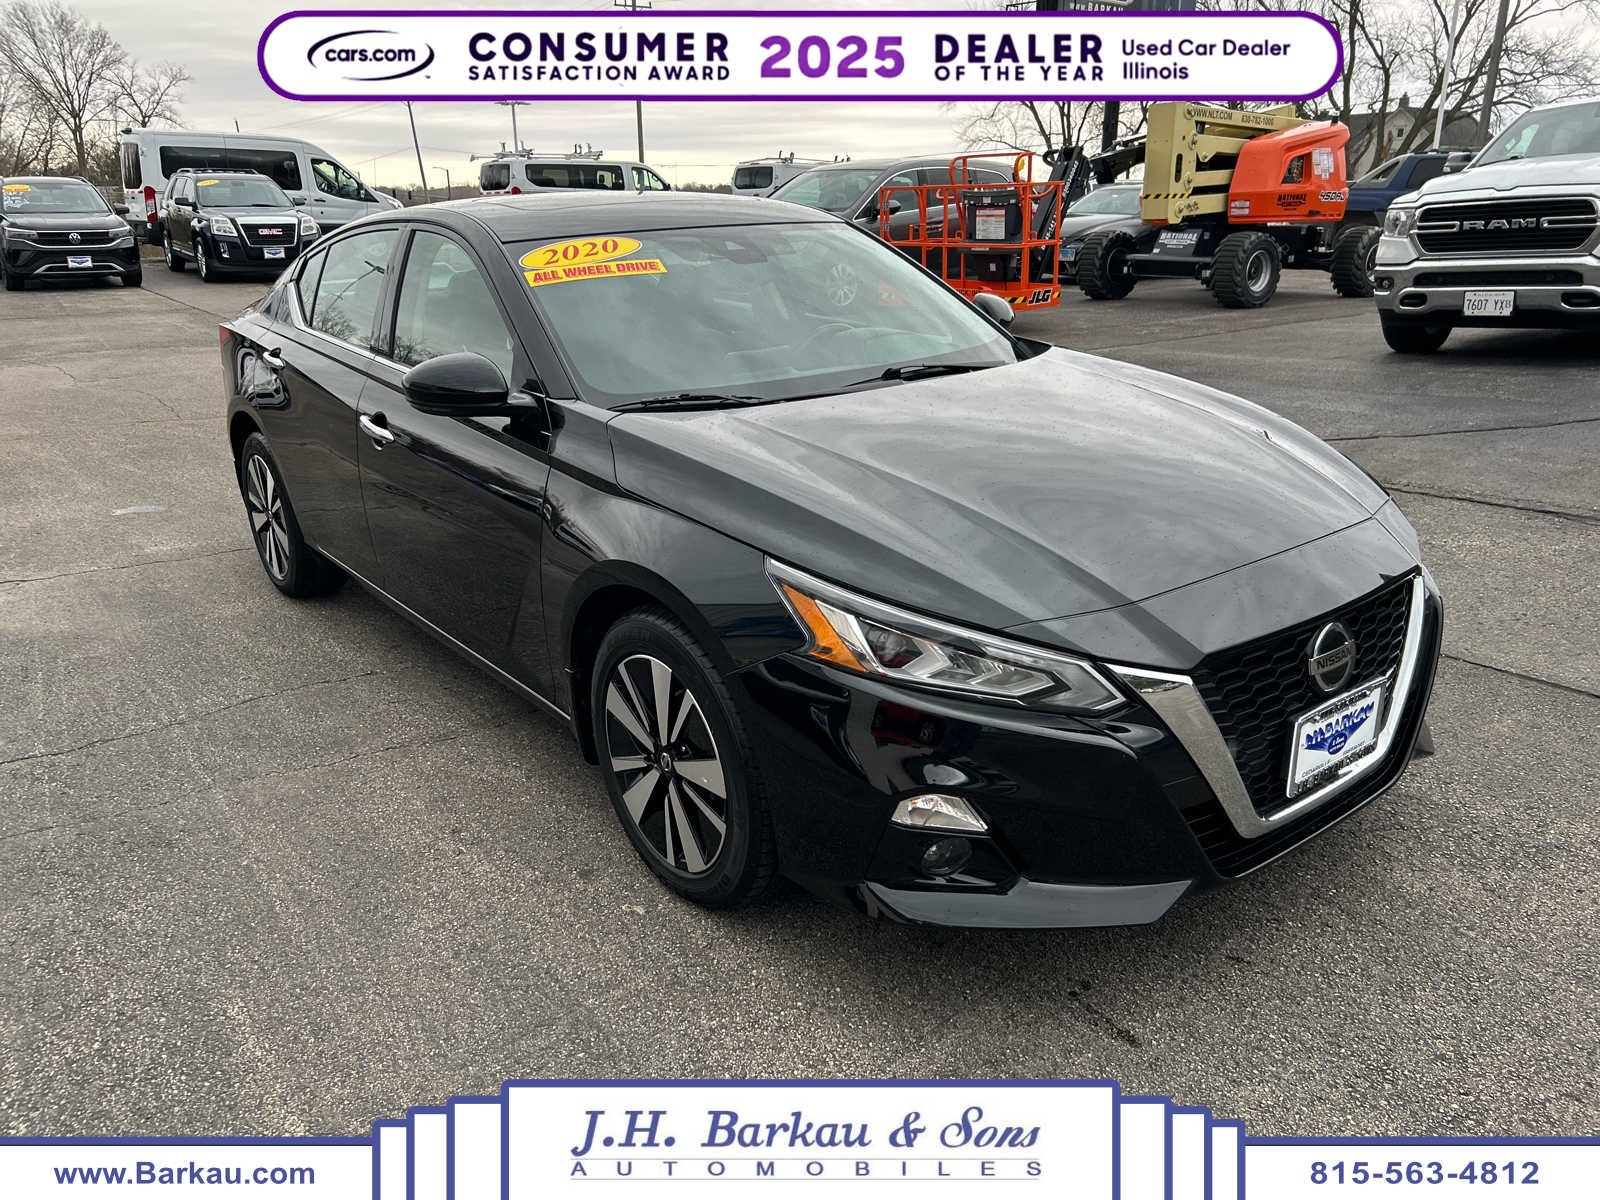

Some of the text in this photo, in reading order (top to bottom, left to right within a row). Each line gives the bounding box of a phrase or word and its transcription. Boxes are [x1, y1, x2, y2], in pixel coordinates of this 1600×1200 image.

[1462, 218, 1537, 230] RAM
[258, 228, 283, 236] GMC
[1160, 232, 1198, 241] NATIONAL
[543, 238, 619, 266] 2020
[532, 261, 661, 283] ALL WHEEL DRIVE
[1027, 289, 1052, 304] JLG
[1466, 298, 1489, 311] 7607
[1316, 645, 1351, 670] NISSAN
